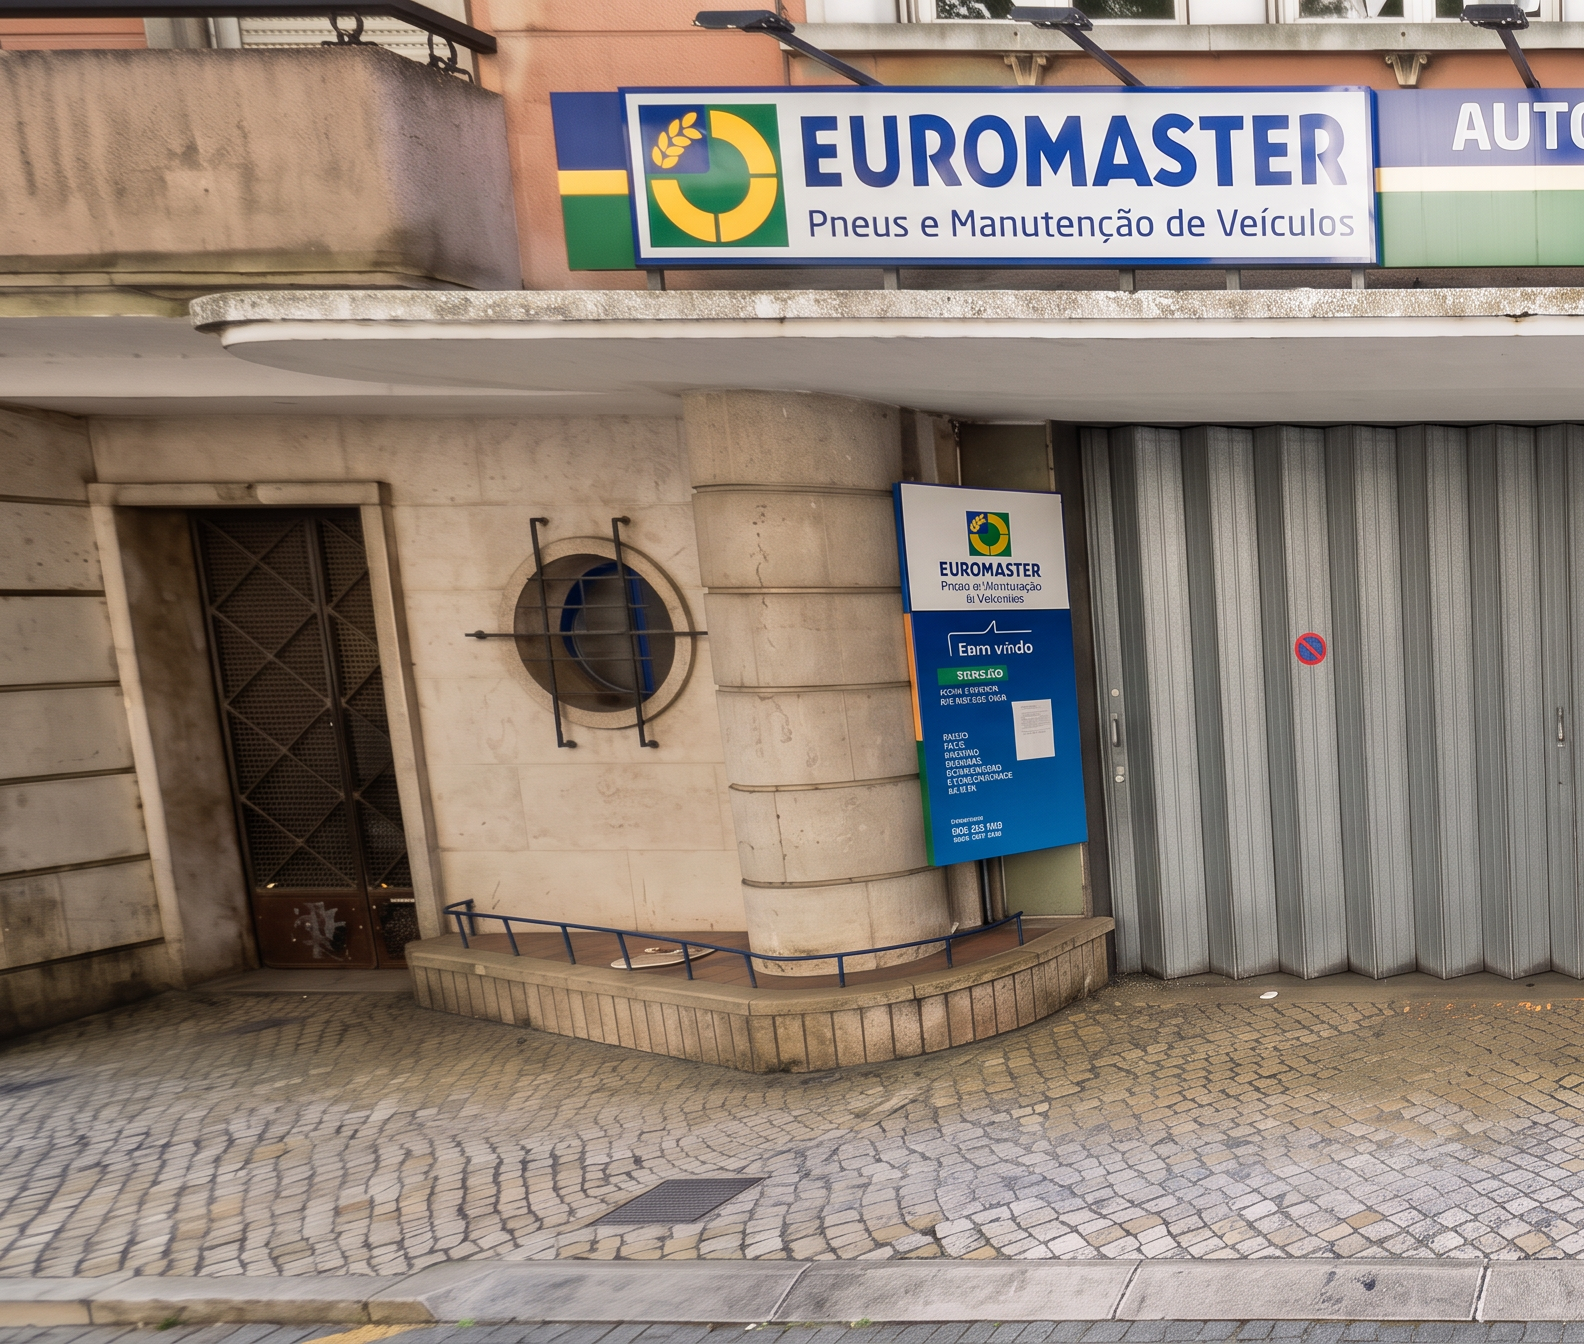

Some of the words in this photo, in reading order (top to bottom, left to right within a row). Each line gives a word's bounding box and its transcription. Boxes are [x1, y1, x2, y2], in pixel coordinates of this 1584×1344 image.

[800, 113, 1348, 188] EUROMASTER
[808, 209, 909, 238] Pneus
[920, 215, 939, 238] e
[951, 208, 1154, 244] Manutenção
[1166, 208, 1205, 237] de
[1216, 207, 1355, 237] Veículos
[939, 561, 1042, 578] EUROMASTER
